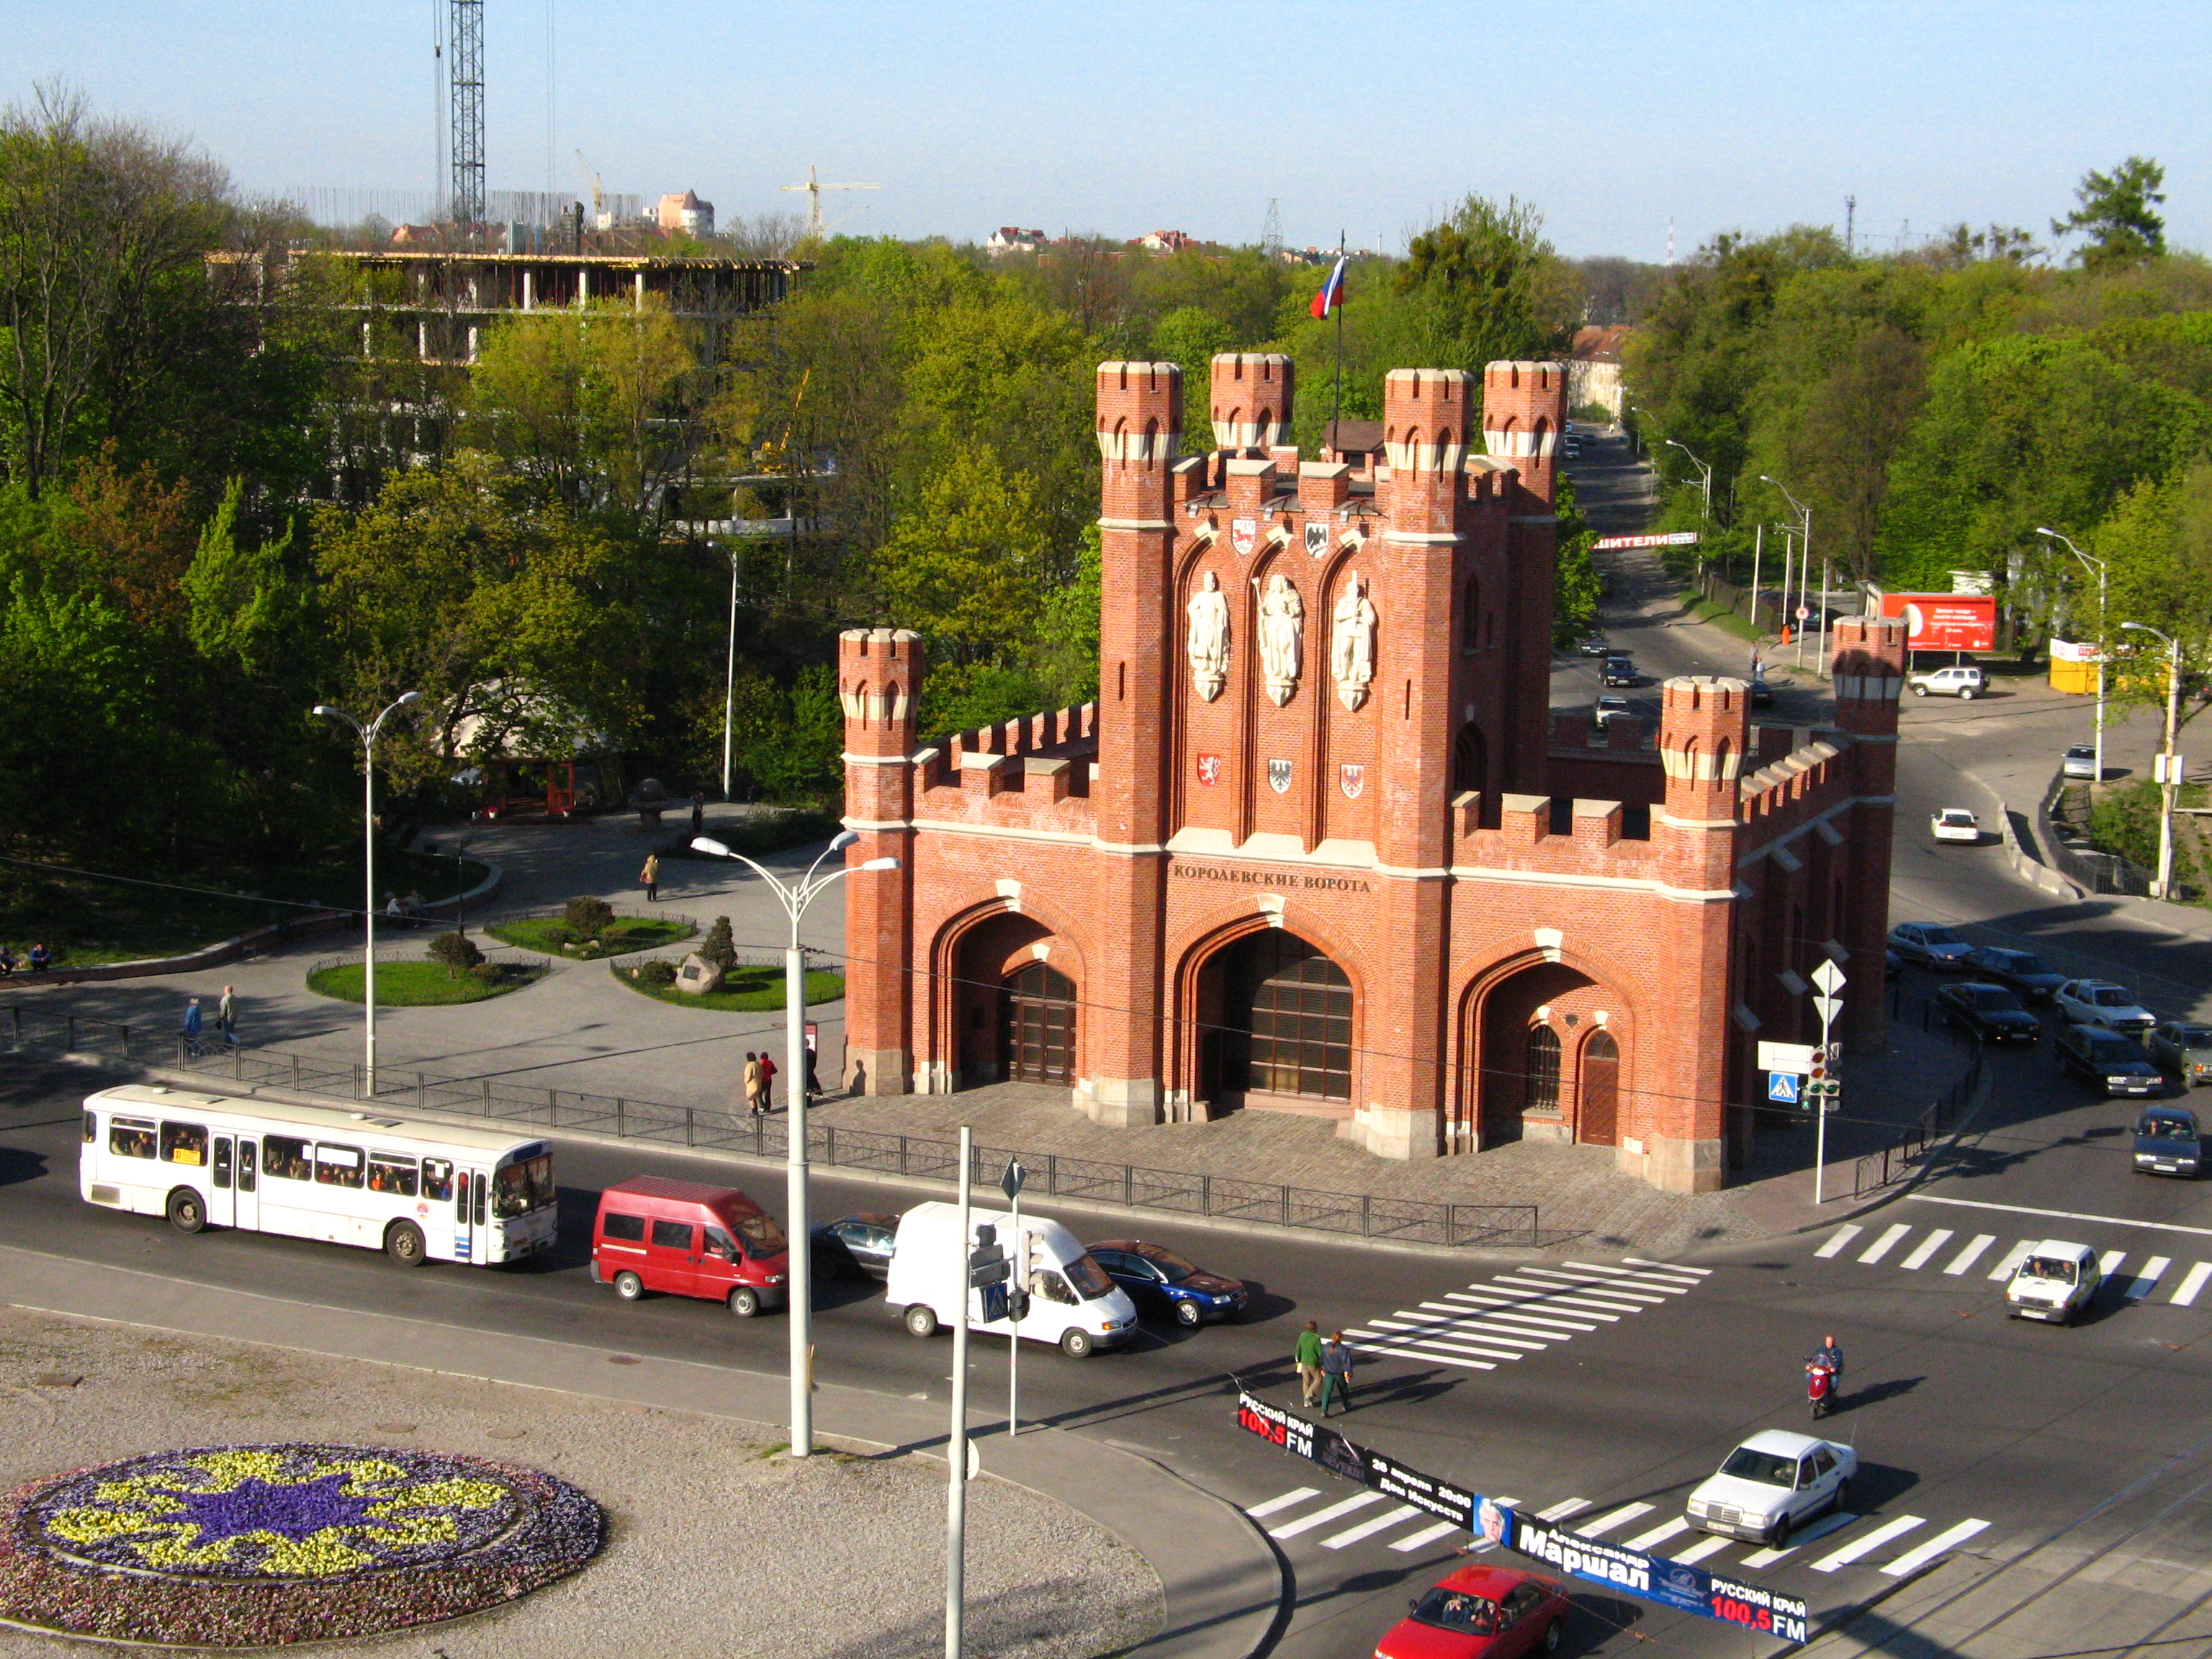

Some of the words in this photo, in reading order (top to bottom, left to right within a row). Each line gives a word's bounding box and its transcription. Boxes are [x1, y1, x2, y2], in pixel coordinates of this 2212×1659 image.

[1174, 865, 1298, 887] КОРОЛЕВСКИЕ
[1303, 876, 1371, 893] ВОРОТА
[1238, 1408, 1287, 1445] 100,5
[1286, 1431, 1313, 1459] FM
[1239, 1393, 1287, 1425] РУССКИЙ
[1287, 1416, 1313, 1438] КРАЙ
[1372, 1458, 1388, 1473] 26
[1390, 1467, 1433, 1493] апреля
[1438, 1486, 1472, 1509] 20:00
[1380, 1478, 1406, 1497] Дом
[1408, 1489, 1464, 1521] Искусств
[1519, 1524, 1650, 1591] Маршал
[1548, 1529, 1650, 1569] Александр
[1711, 1578, 1771, 1608] РУССКИЙ
[1772, 1596, 1806, 1618] КРАЙ
[1711, 1596, 1772, 1630] 100,5
[1772, 1614, 1805, 1642] FM
